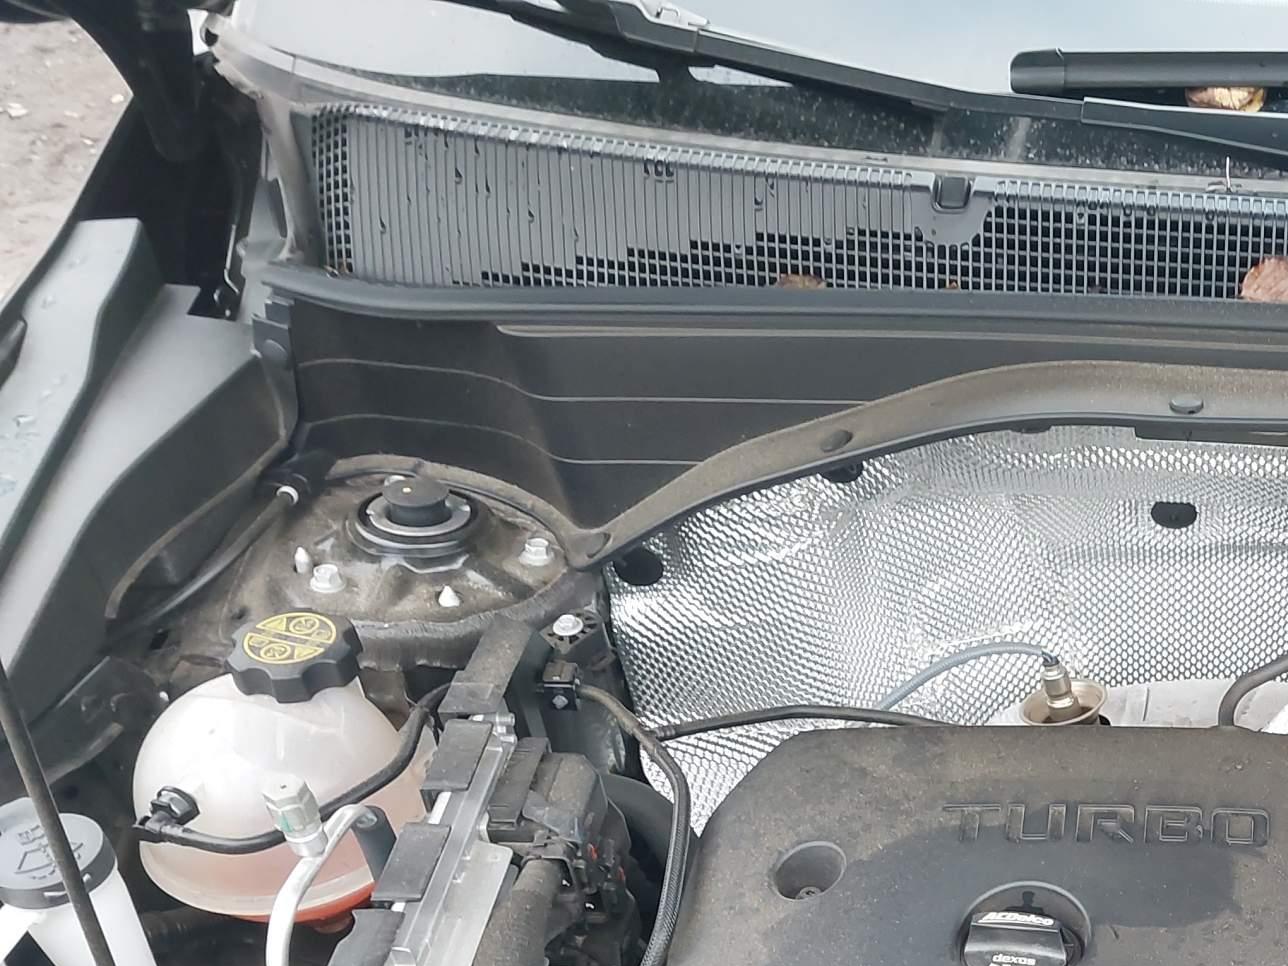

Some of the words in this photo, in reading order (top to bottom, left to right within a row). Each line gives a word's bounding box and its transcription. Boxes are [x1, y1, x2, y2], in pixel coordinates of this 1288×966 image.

[942, 803, 1271, 848] TURBO
[978, 911, 1054, 926] ACDelco
[992, 953, 1036, 966] dexos
